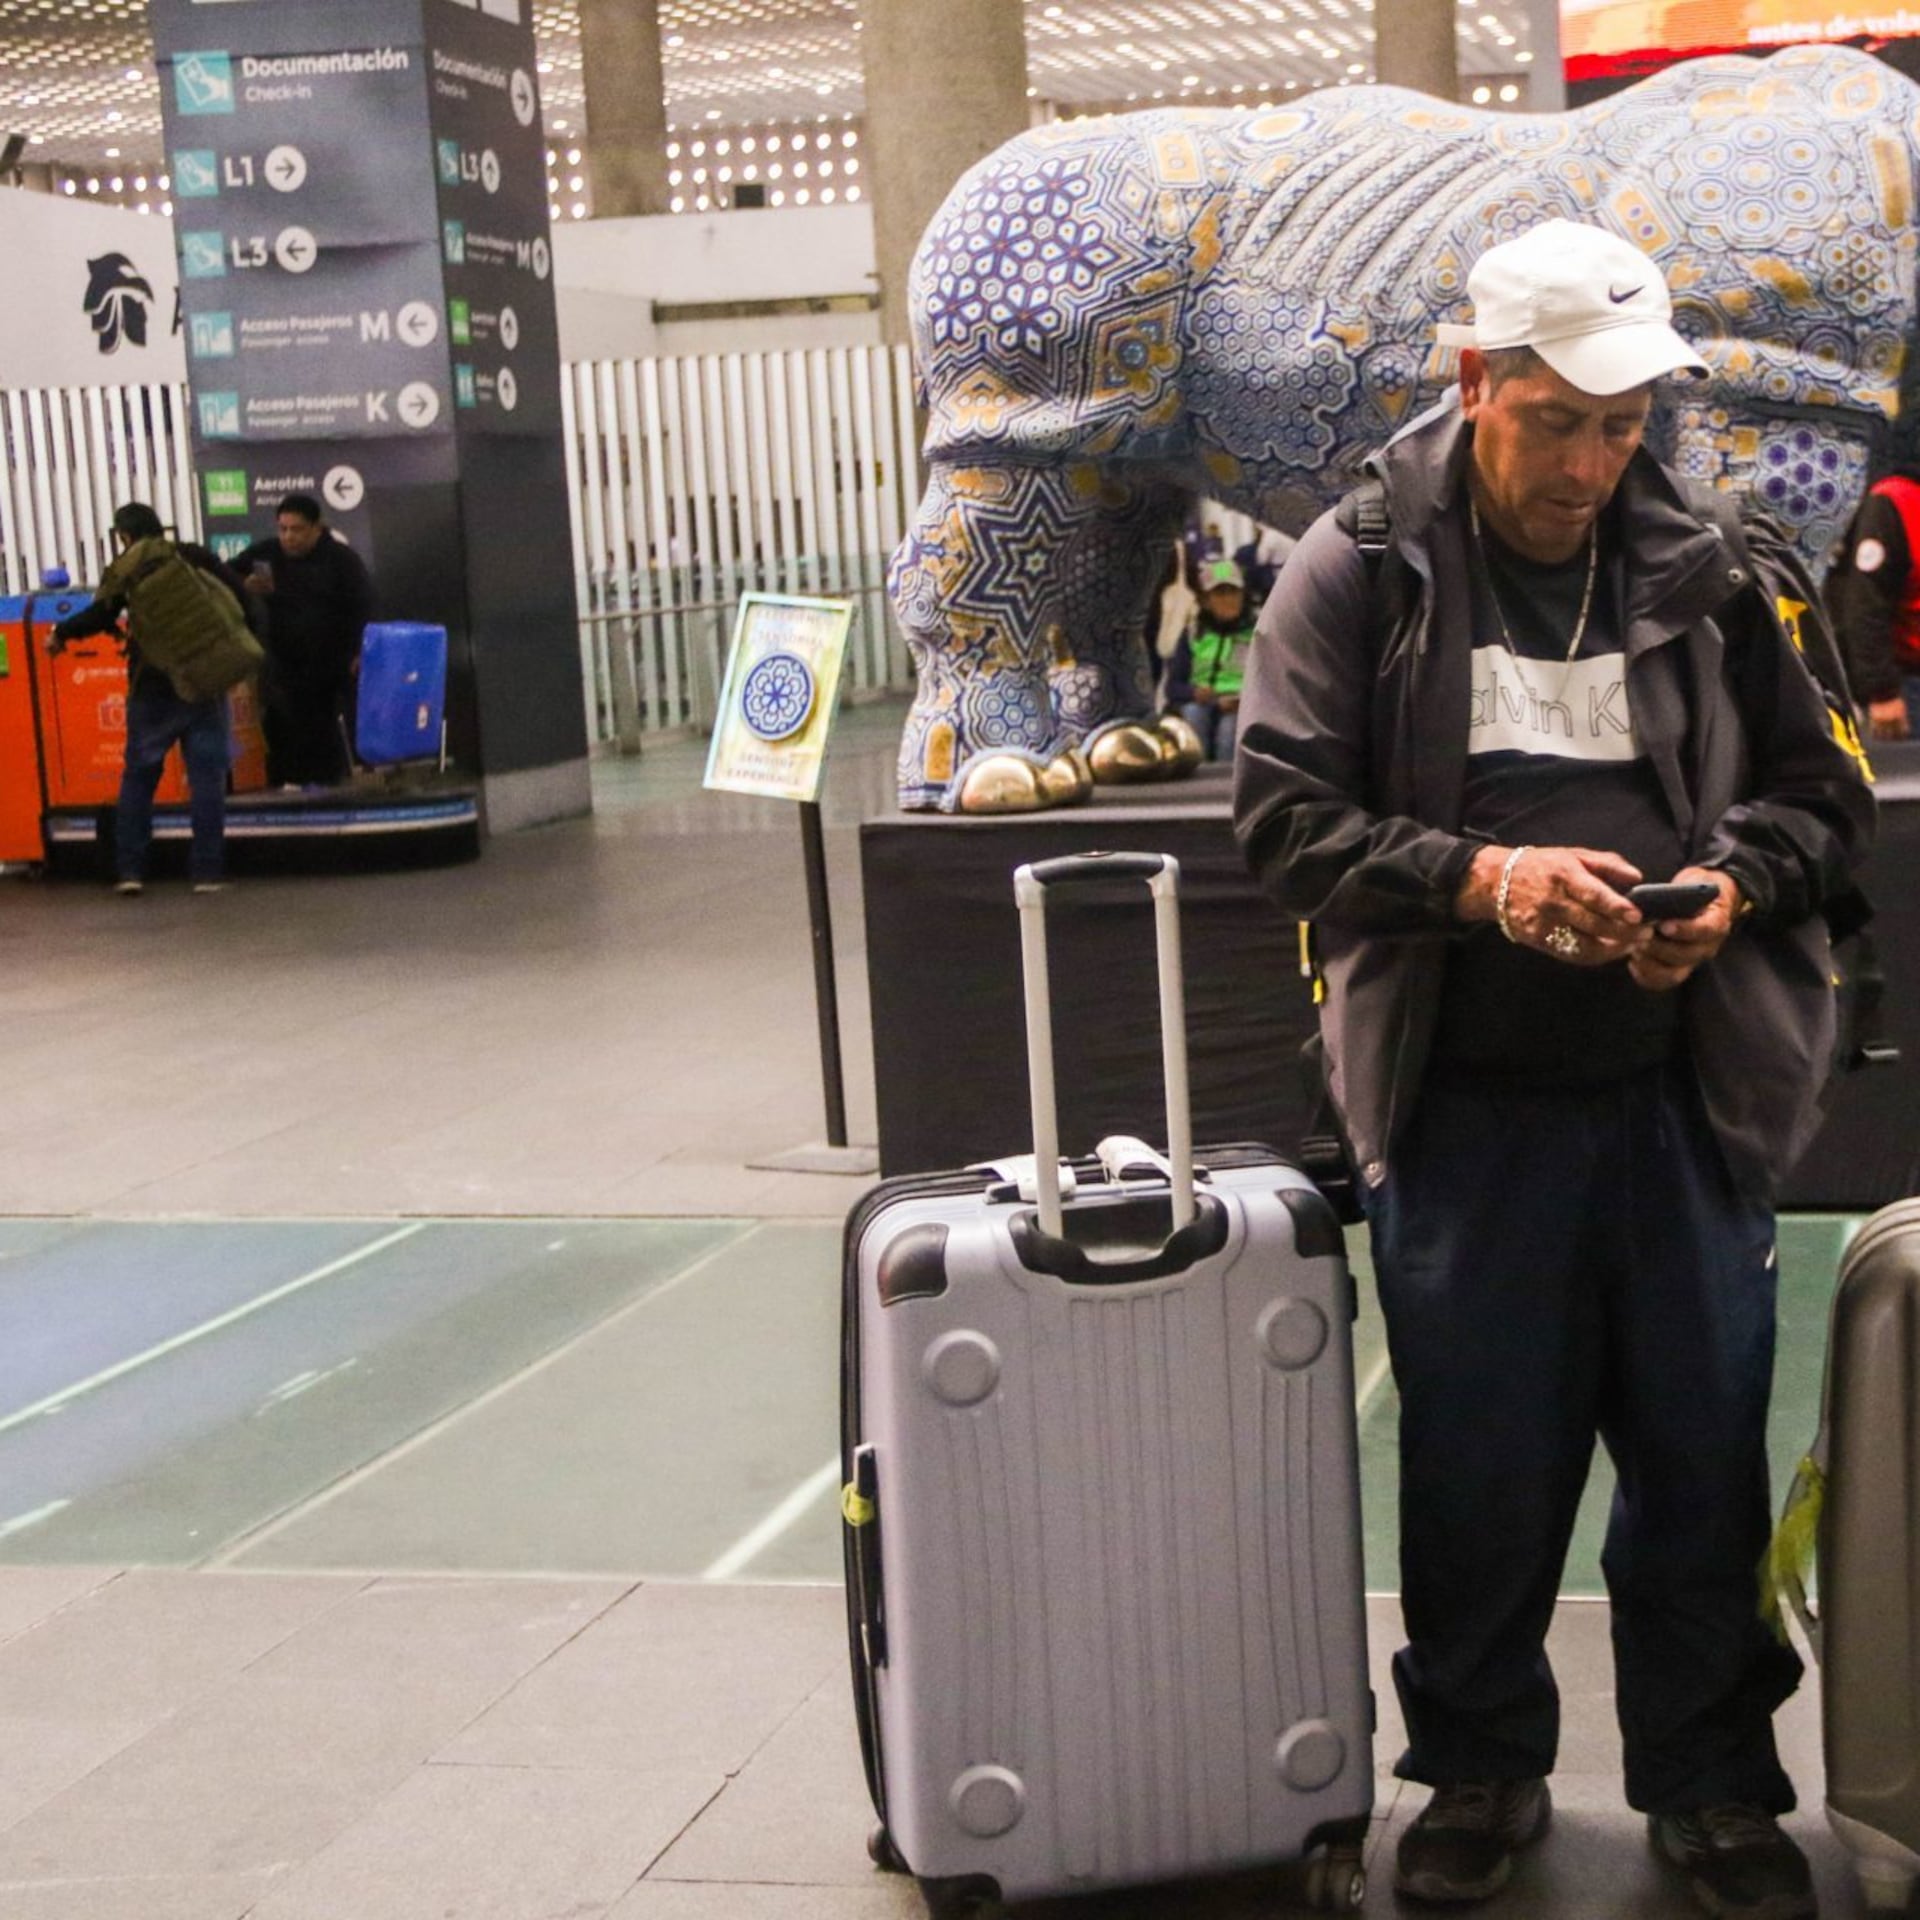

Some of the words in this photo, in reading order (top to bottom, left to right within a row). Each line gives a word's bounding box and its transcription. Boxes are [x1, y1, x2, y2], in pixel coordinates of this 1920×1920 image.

[242, 46, 410, 78] Documentación
[244, 83, 313, 102] Check-in
[223, 155, 254, 188] L1
[460, 151, 480, 181] L3
[230, 235, 269, 269] L3
[360, 309, 390, 344] M
[365, 390, 389, 424] K
[254, 474, 315, 491] Aerotrén
[1588, 680, 1629, 737] K
